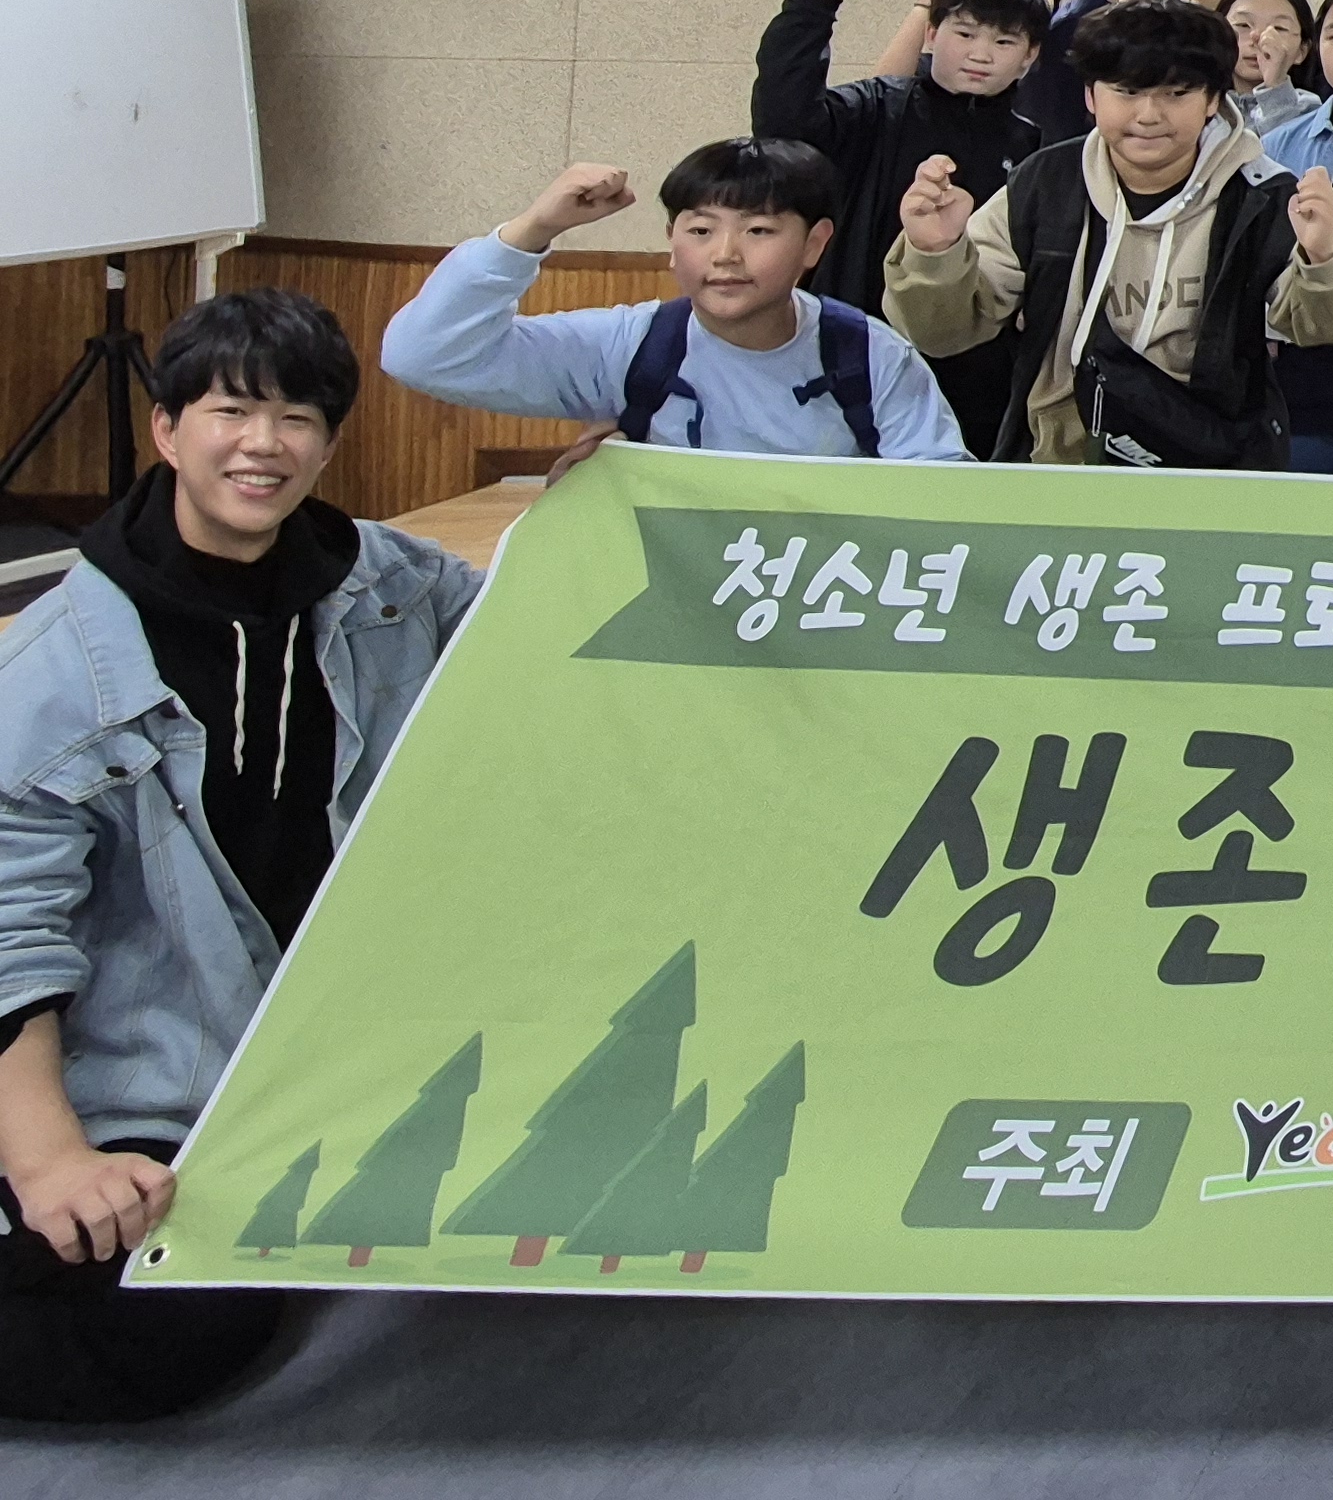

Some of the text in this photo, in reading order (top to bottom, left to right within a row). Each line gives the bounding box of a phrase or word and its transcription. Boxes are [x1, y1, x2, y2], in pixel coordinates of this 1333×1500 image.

[712, 527, 969, 643] 청소년
[1004, 551, 1169, 652] 생존
[962, 1117, 1140, 1213] 주최
